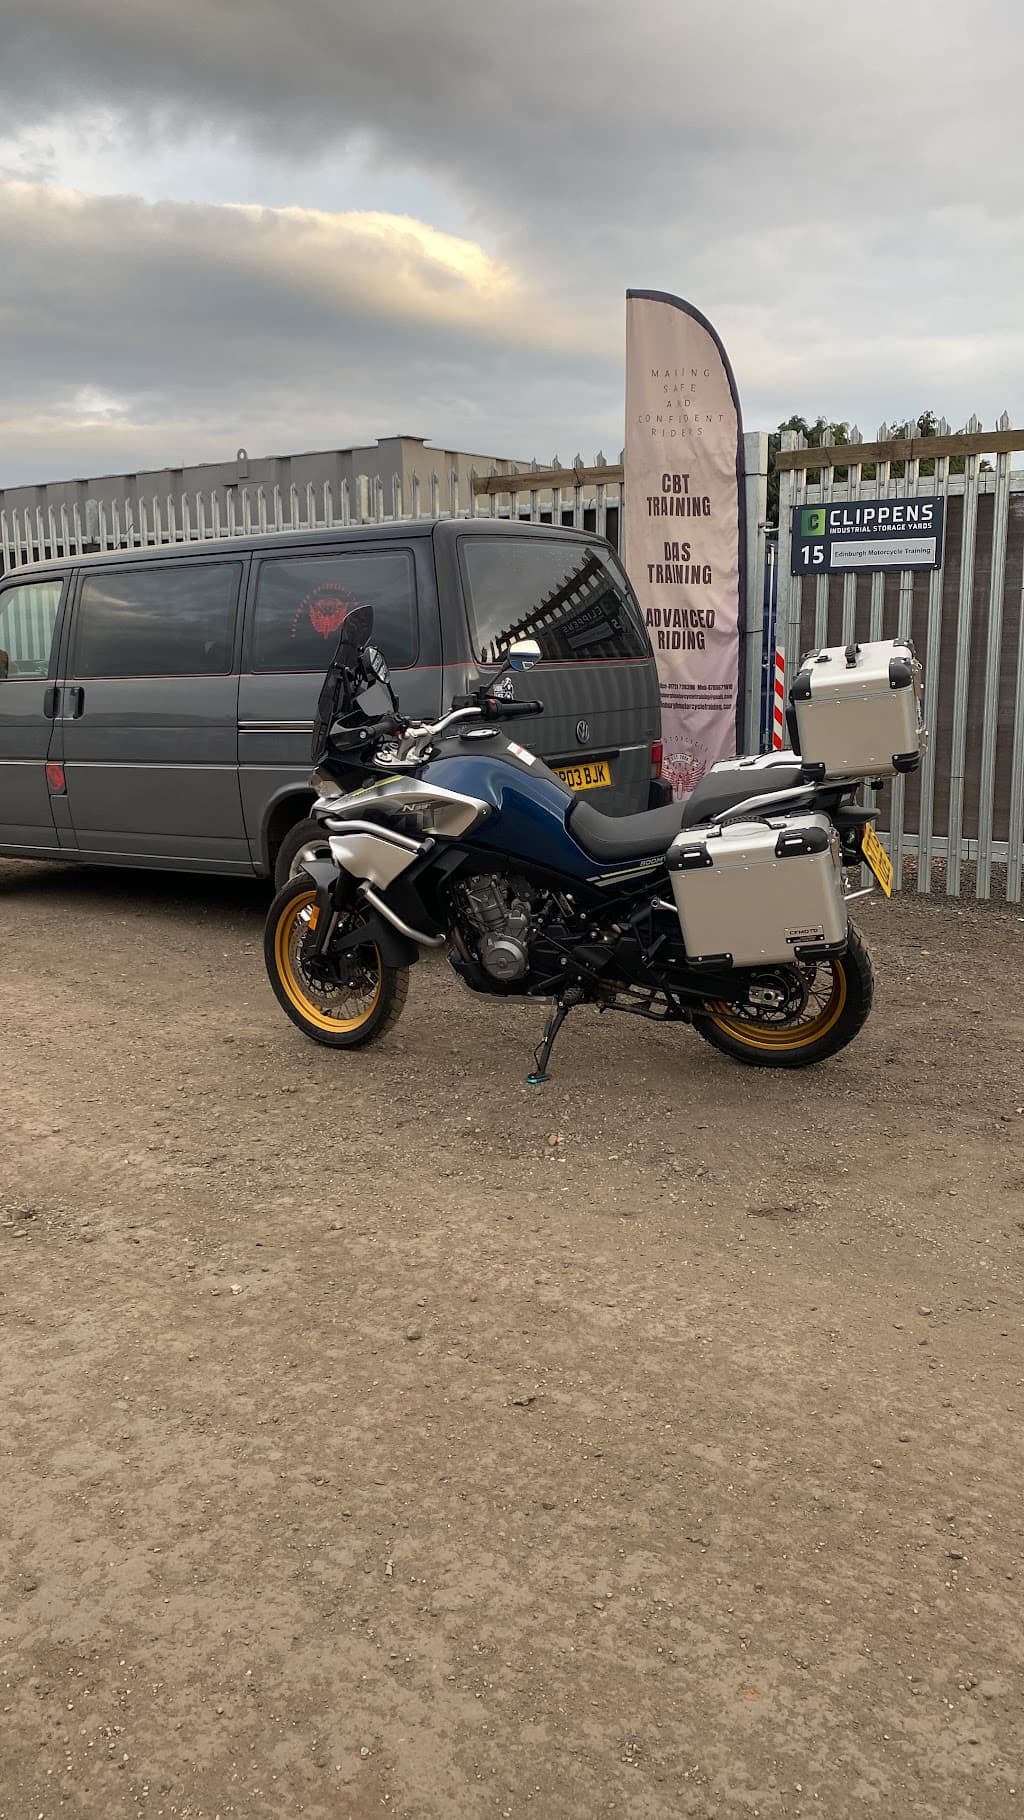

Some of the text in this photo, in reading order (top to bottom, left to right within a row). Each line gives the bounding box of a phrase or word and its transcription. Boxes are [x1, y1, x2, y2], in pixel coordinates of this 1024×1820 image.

[663, 384, 696, 393] SAFE
[638, 414, 724, 423] CONFIDENT
[651, 427, 703, 437] RIDERS
[662, 473, 690, 494] CBT
[647, 496, 711, 517] TRAINING
[830, 504, 933, 526] CLIPPENS
[829, 522, 933, 534] INDUSTRIAL STORAGE YARDS
[664, 541, 691, 562] DAS
[801, 545, 824, 564] 15
[868, 549, 903, 557] Motorcycle
[905, 547, 931, 555] Training
[647, 564, 712, 585] TRAINING
[646, 608, 715, 629] ADVANCED
[658, 630, 706, 650] RIDING
[554, 765, 606, 787] P03 BJK
